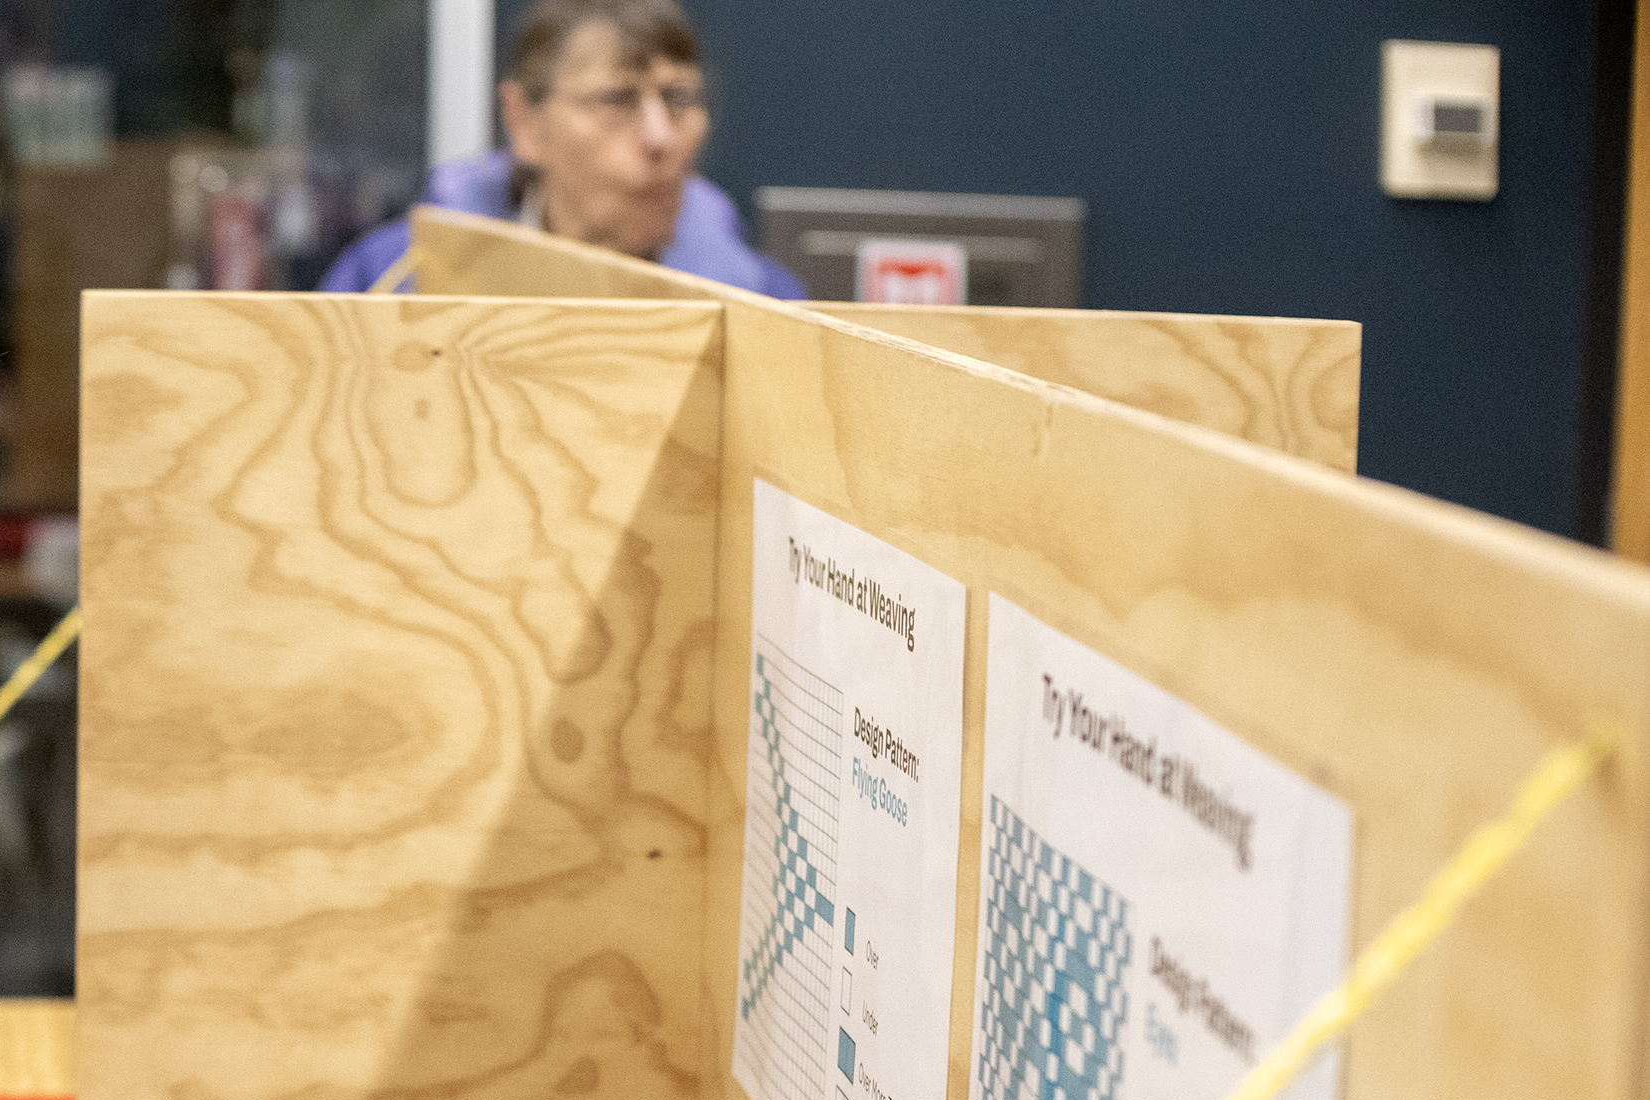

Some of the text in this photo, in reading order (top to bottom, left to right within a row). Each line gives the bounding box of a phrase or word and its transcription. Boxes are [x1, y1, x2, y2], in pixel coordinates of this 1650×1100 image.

[803, 544, 826, 590] Your
[827, 557, 855, 607] Hand
[857, 577, 867, 614] at
[870, 579, 916, 652] Weaving
[854, 706, 919, 783] Design Pattern:
[852, 756, 907, 827] Flying Goose
[866, 940, 879, 970] Over
[862, 1000, 879, 1036] Under
[858, 1062, 871, 1092] Over
